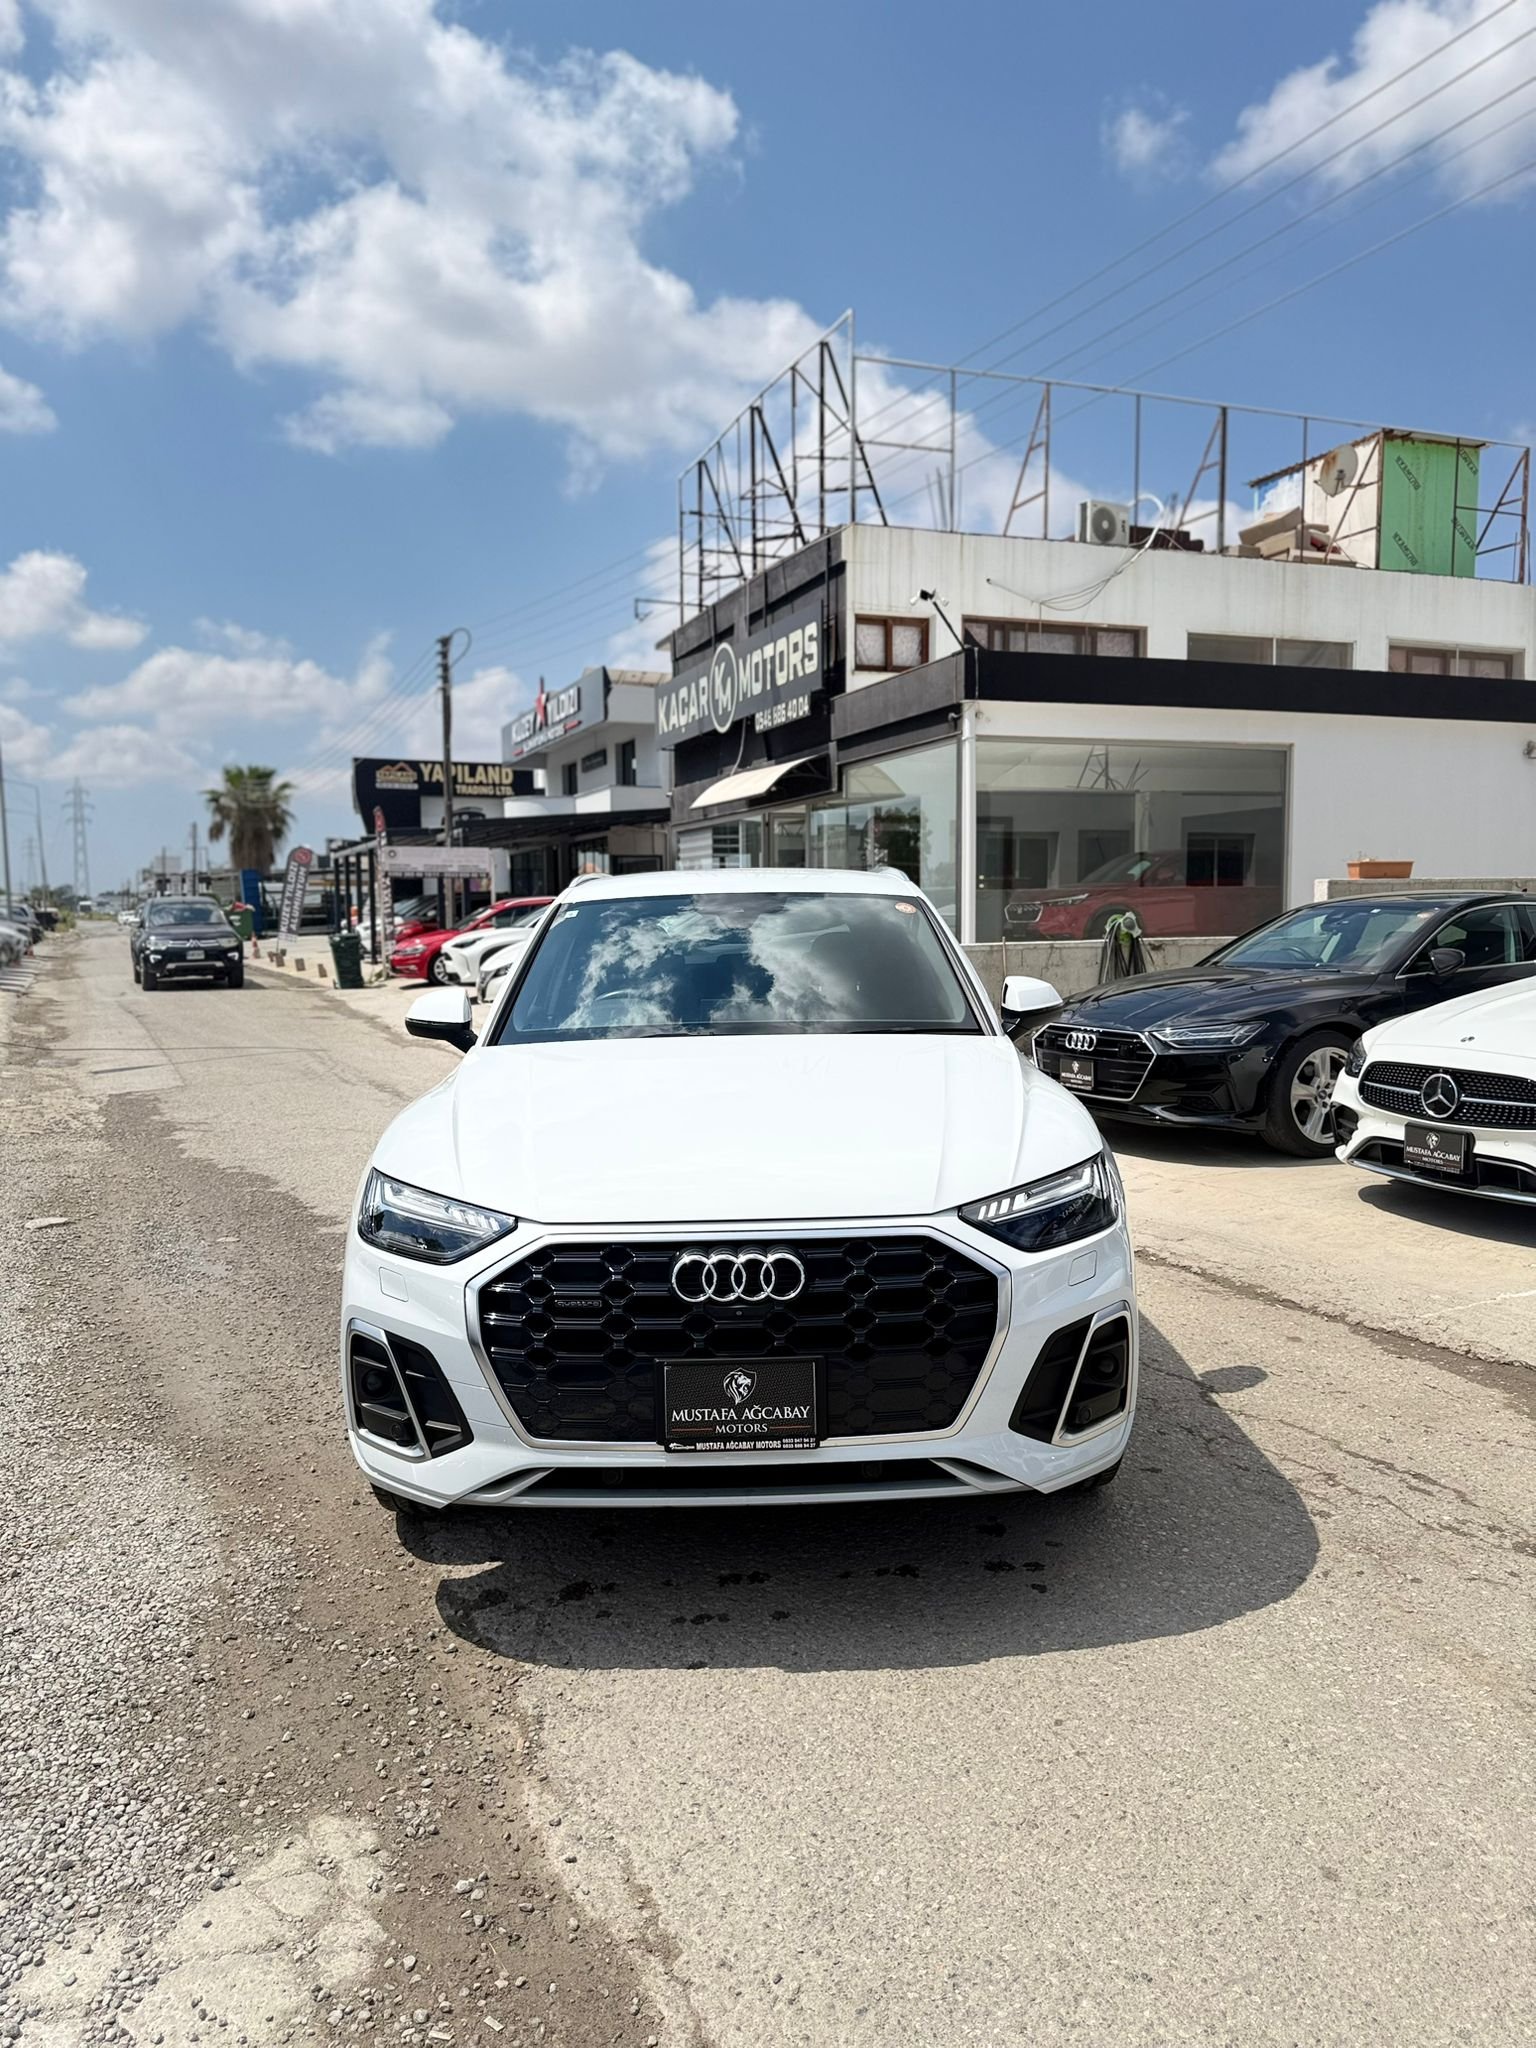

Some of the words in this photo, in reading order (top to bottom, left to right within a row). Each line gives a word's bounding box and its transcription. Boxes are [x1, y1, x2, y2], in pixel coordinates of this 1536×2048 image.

[739, 621, 818, 702] MOTORS
[658, 676, 708, 735] KAÇAR
[280, 898, 291, 932] KUZEY
[1406, 1146, 1432, 1156] MUSTAFA
[671, 1408, 736, 1422] MUSTAFA
[742, 1404, 810, 1420] AĞCABAY
[715, 1423, 768, 1434] MOTORS
[696, 1442, 725, 1450] MUSTAFA
[755, 1440, 781, 1449] MOTORS
